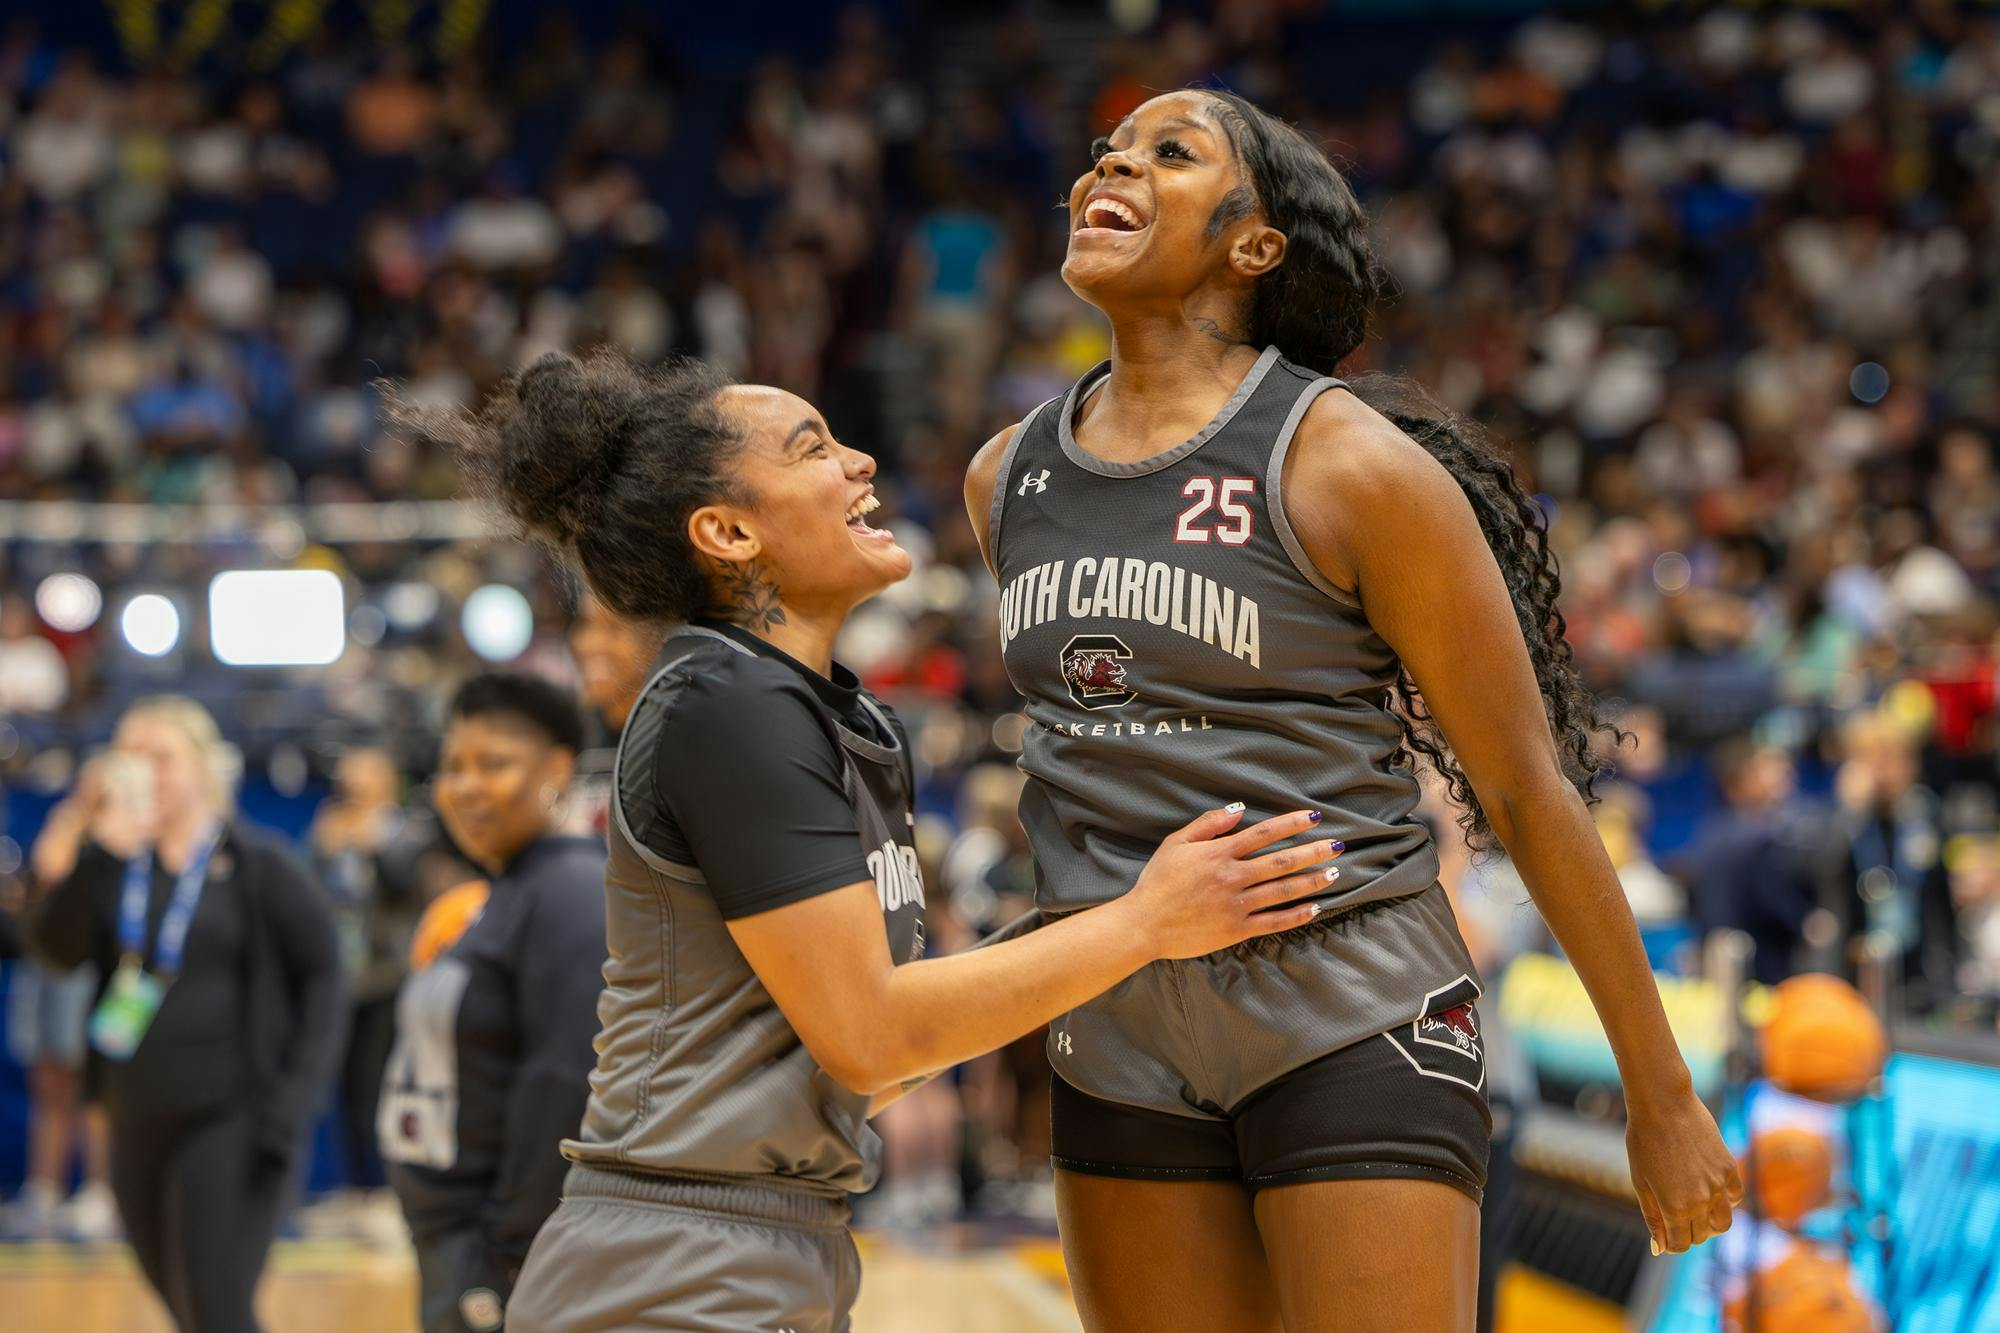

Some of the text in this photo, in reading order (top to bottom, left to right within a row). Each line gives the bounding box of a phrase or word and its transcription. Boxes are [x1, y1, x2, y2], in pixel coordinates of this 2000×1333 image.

[1174, 475, 1255, 547] 25
[999, 557, 1260, 670] OUTH CAROLINA
